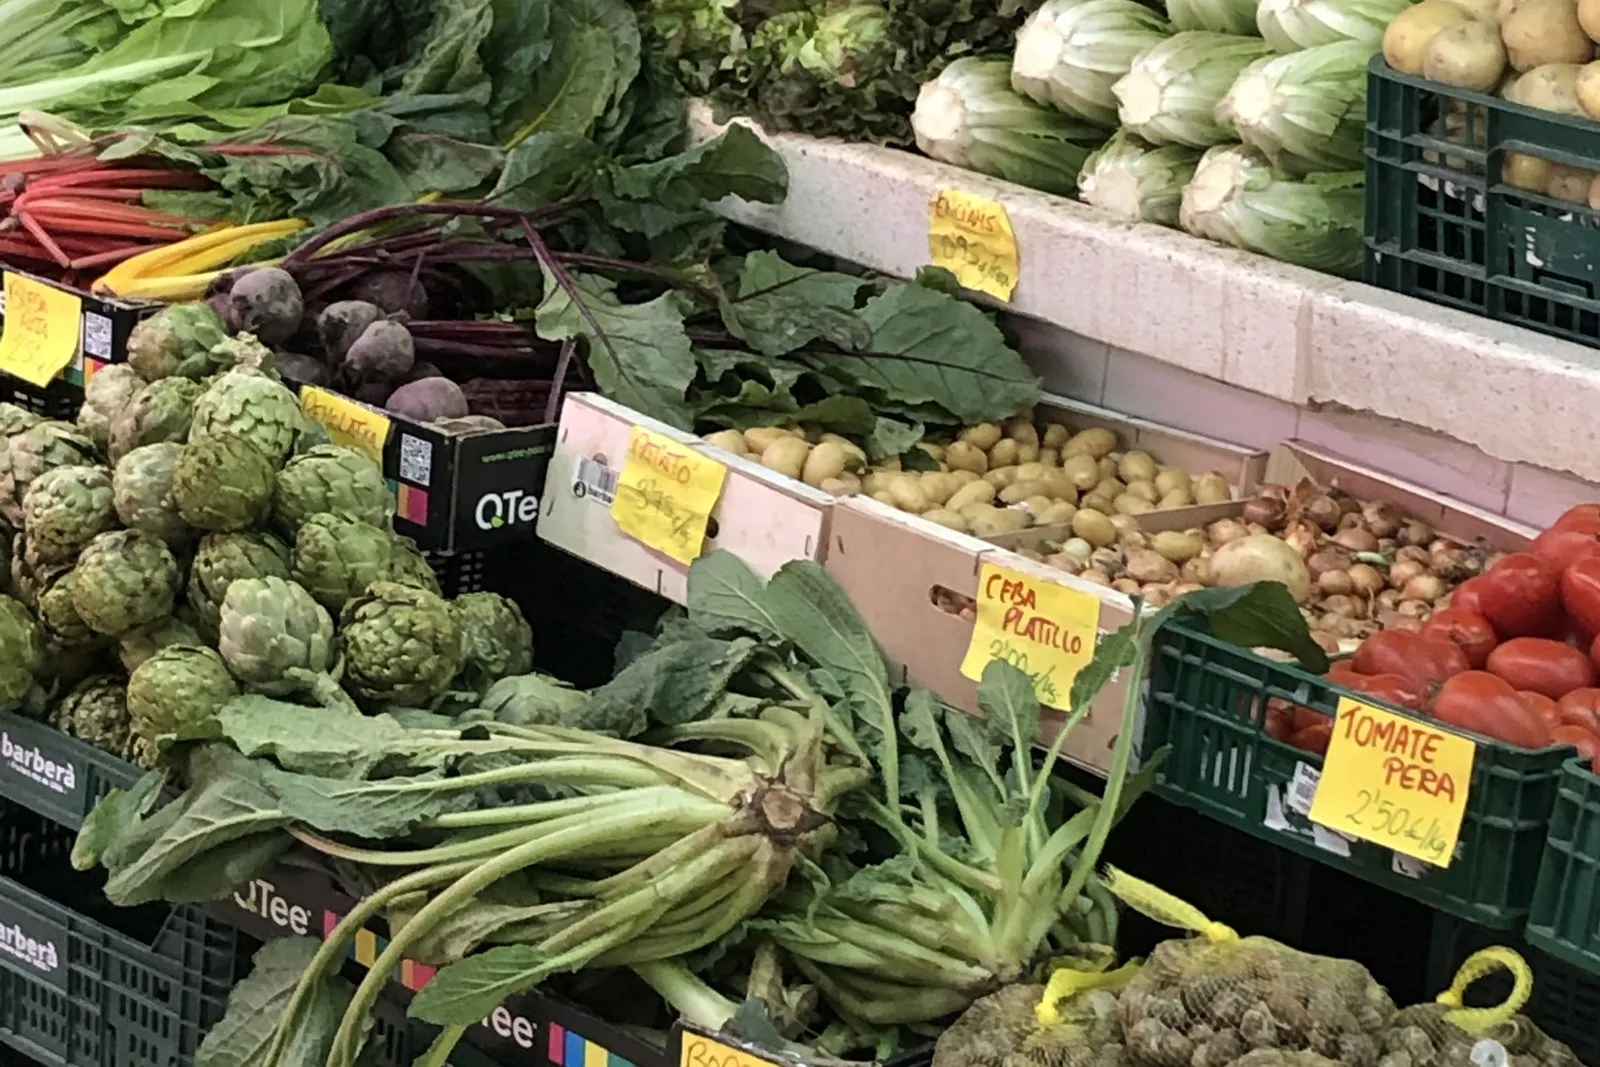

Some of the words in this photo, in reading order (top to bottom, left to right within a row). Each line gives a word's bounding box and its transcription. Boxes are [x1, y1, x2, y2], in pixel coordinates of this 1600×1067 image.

[986, 574, 1036, 610] CEBA
[1002, 606, 1081, 654] PLATILLO
[1341, 706, 1444, 763] TOMATE
[2, 732, 76, 789] barberà
[1383, 757, 1455, 803] PERA
